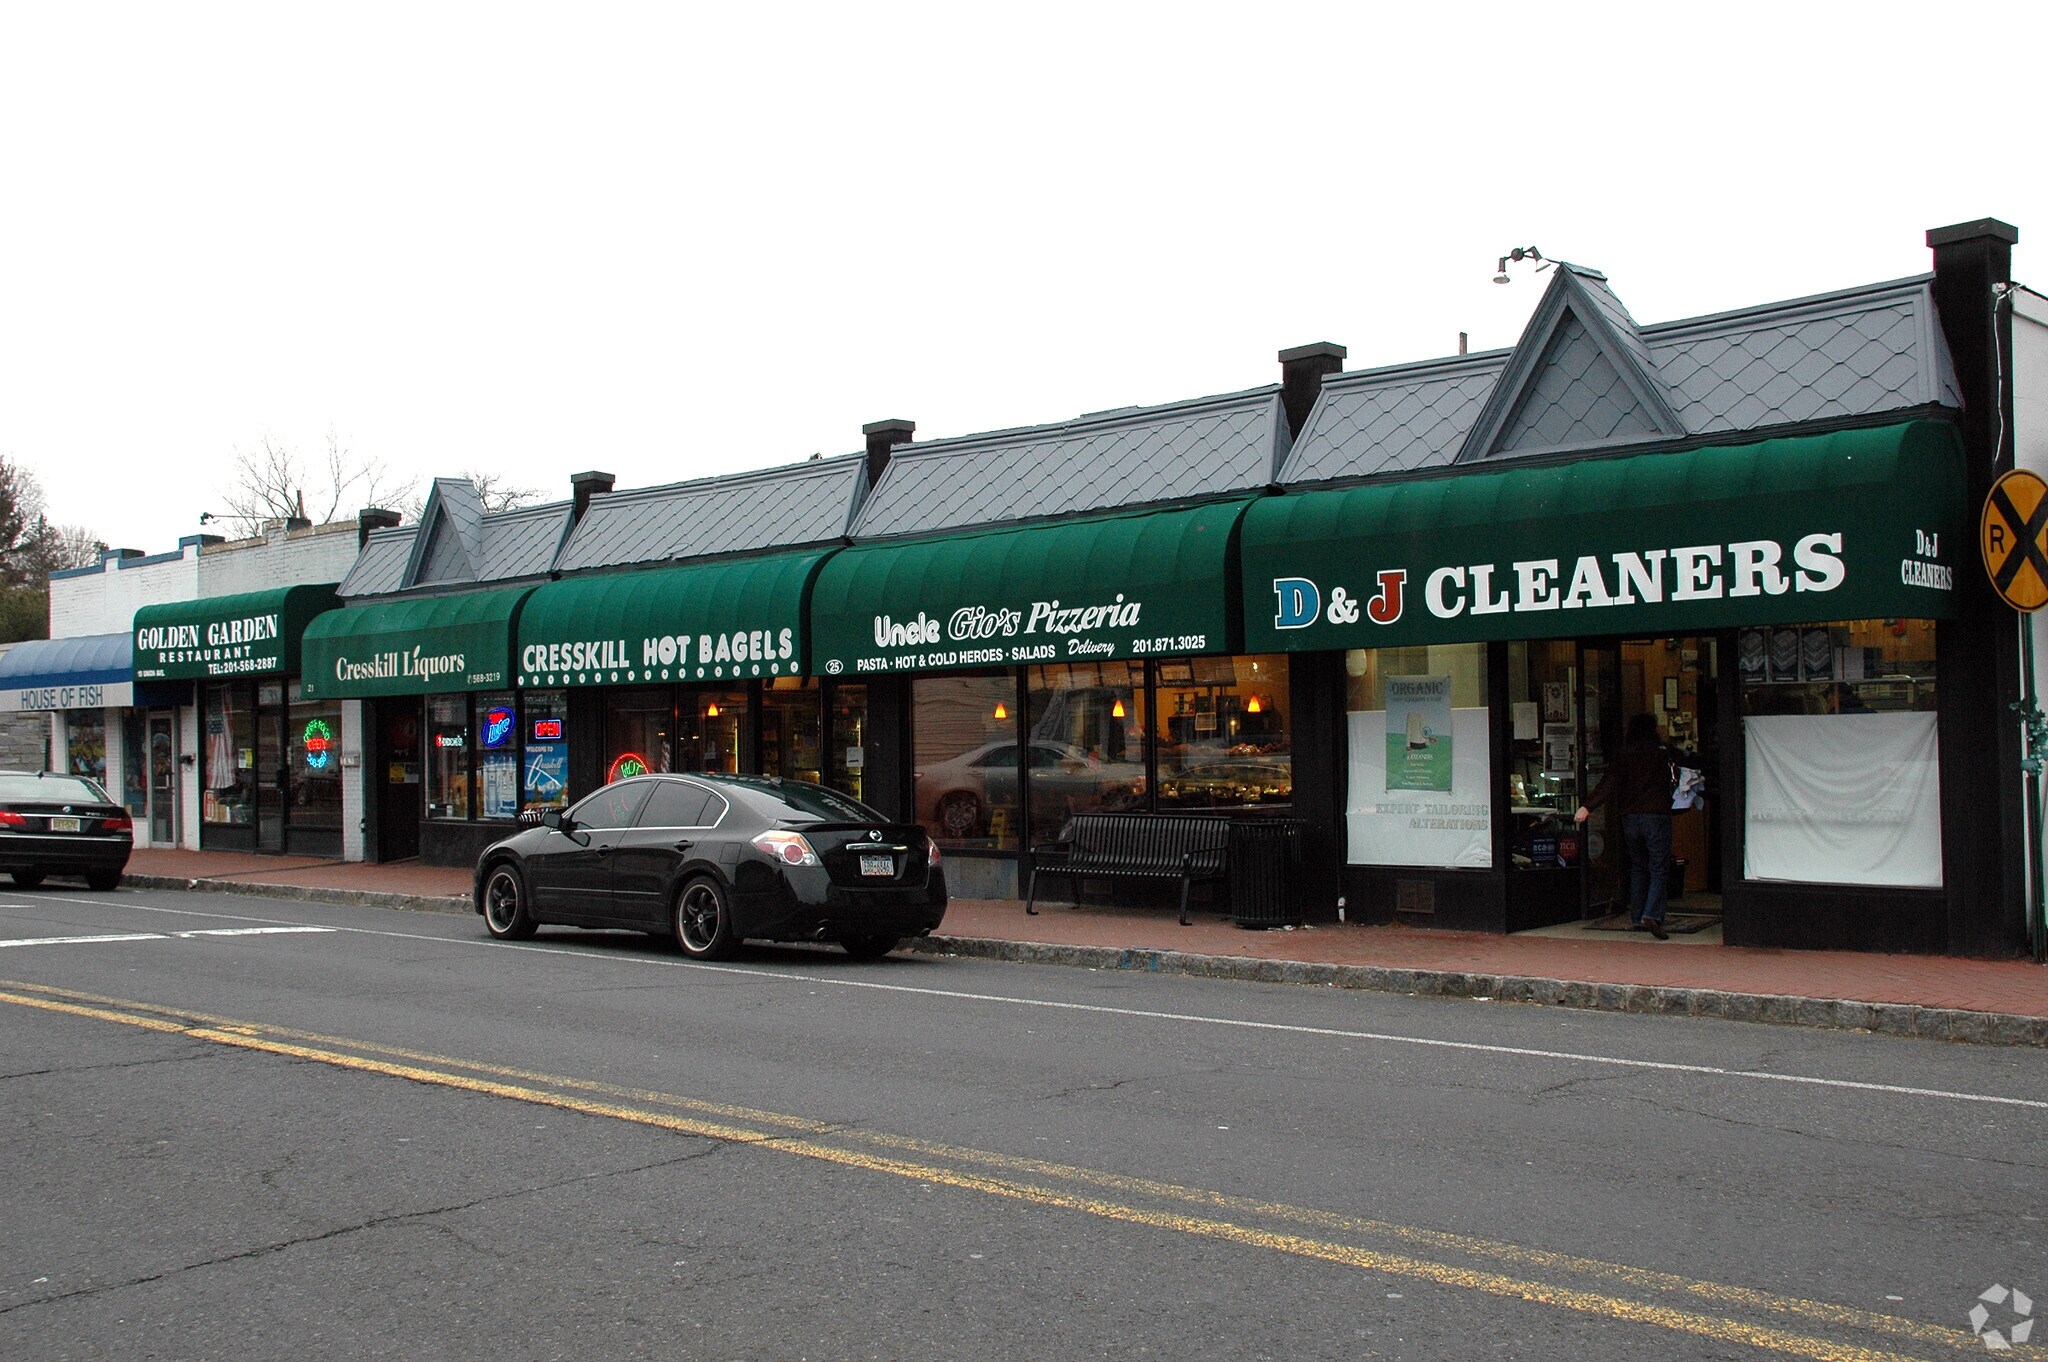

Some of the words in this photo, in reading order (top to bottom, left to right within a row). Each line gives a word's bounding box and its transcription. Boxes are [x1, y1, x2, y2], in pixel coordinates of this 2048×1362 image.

[1424, 533, 1846, 619] CLEANERS
[1901, 559, 1953, 591] CLEANERS
[137, 624, 200, 650] GOLDEN
[207, 613, 278, 647] GARDEN
[874, 611, 941, 648] Uncle
[948, 605, 1022, 641] Gio's
[1023, 593, 1142, 635] Pizzeria
[159, 645, 251, 663] RESTAURANT
[336, 651, 398, 682] Cresskill
[402, 645, 465, 682] Liquors
[522, 639, 630, 673] CRESSKILL
[643, 635, 691, 666] HOT
[699, 627, 793, 664] BAGELS
[857, 657, 888, 671] PASTA
[895, 655, 916, 669] HOT
[918, 654, 927, 667] &
[928, 652, 957, 667] COLD
[959, 648, 1003, 664] HEROES
[1011, 645, 1056, 661] SALADS
[1067, 638, 1116, 657] Delivery
[1132, 635, 1206, 653] 201.871.3025
[21, 688, 57, 710] HOUSE
[60, 687, 76, 708] OF
[78, 685, 104, 707] FISH
[1391, 682, 1444, 696] ORGANIC
[1375, 803, 1420, 815] EXPERT
[1424, 803, 1489, 816] TAILORING
[1408, 817, 1489, 831] ALTERATIONS
[1560, 842, 1576, 850] nca
